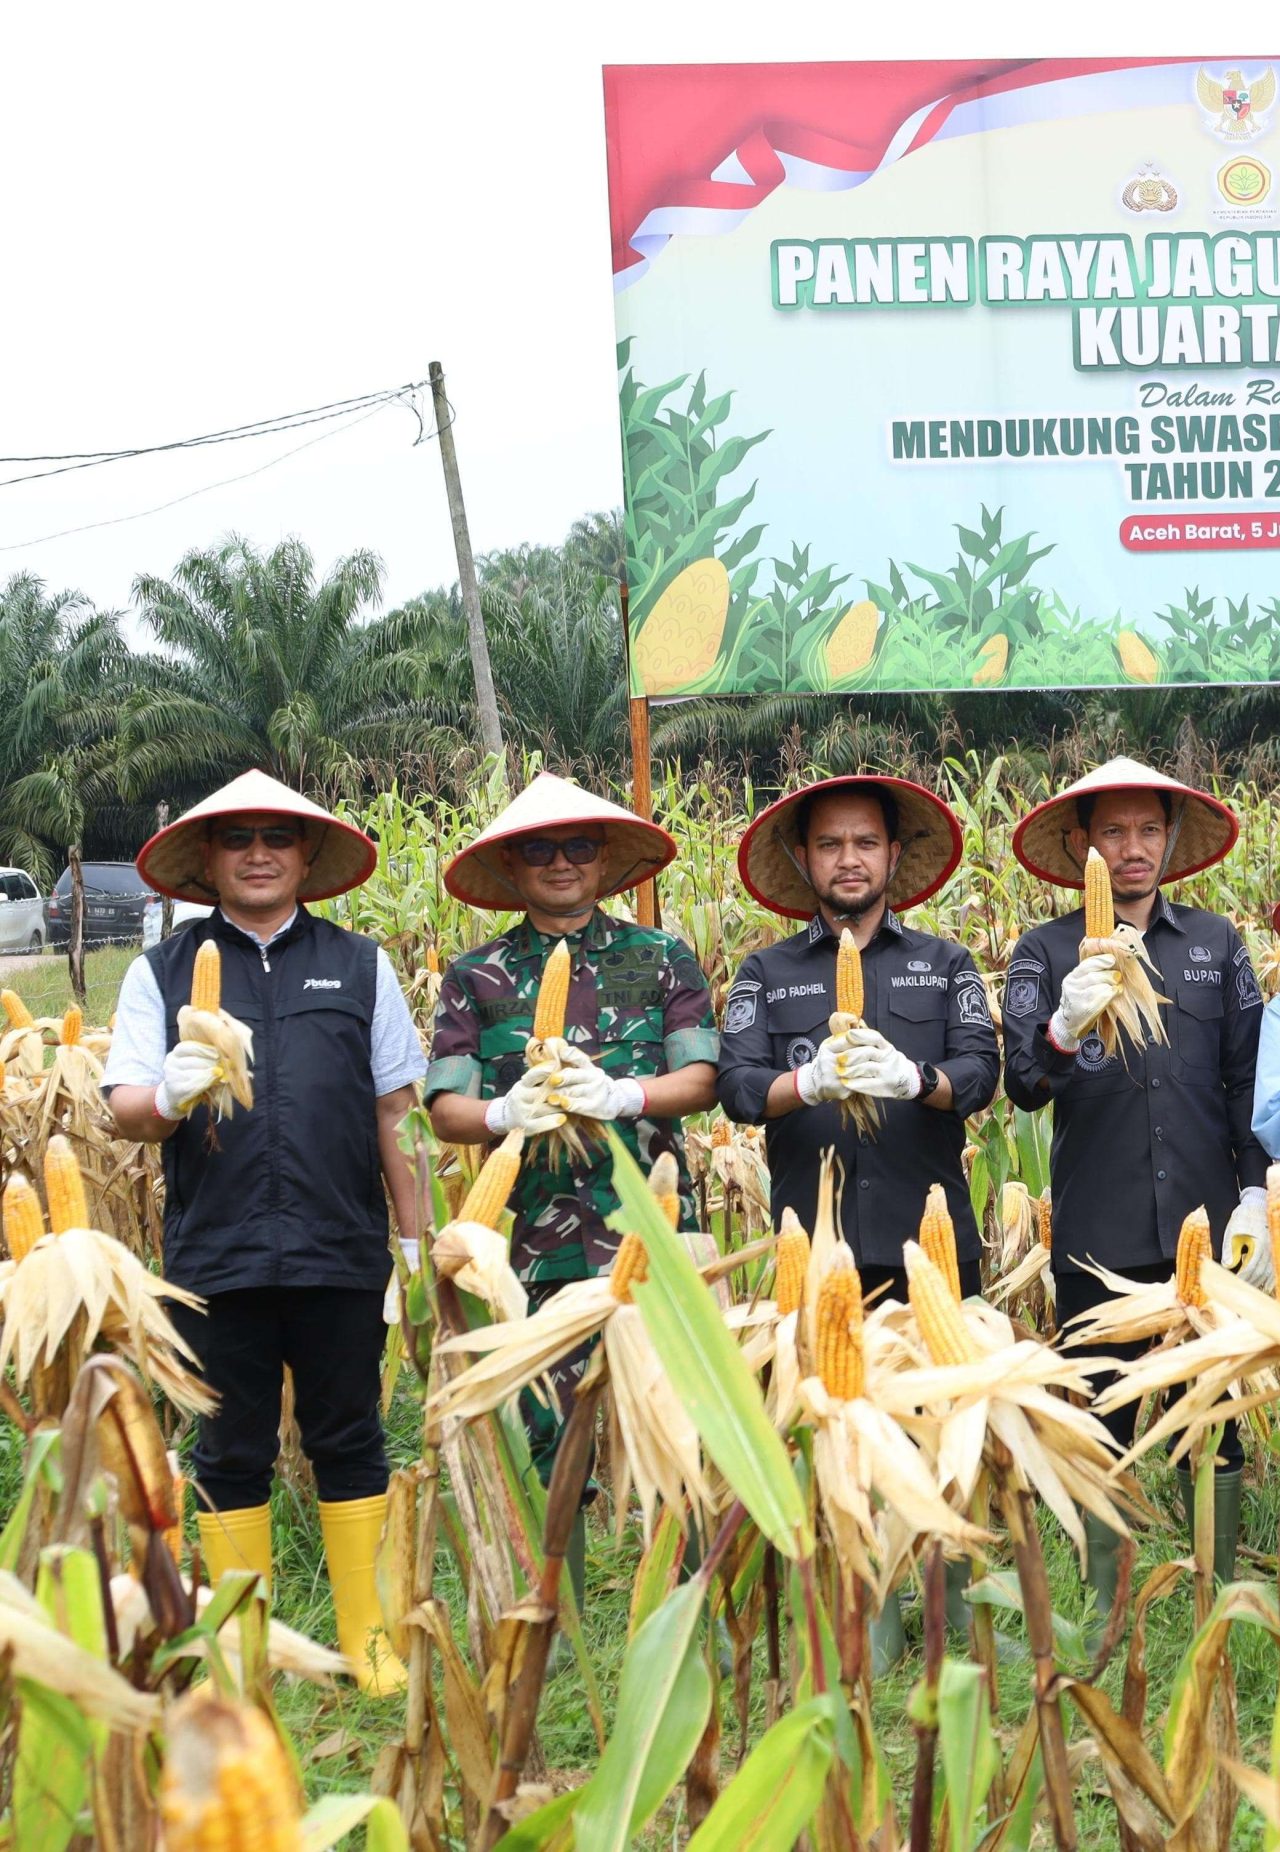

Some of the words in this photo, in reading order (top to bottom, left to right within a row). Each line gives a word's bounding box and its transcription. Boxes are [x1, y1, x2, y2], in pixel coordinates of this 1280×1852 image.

[777, 242, 970, 305] PANEN
[985, 239, 1137, 302] RAYA
[1139, 381, 1237, 408] Dalam
[892, 415, 1141, 459] MENDUKUNG
[1124, 460, 1254, 501] TAHUN
[1129, 524, 1181, 541] Aceh
[1185, 522, 1247, 542] Barat,
[1251, 522, 1263, 538] 5
[311, 978, 342, 989] bulog
[1184, 969, 1222, 985] BUPATI
[766, 988, 787, 1004] SAID
[789, 983, 827, 998] FADHEIL
